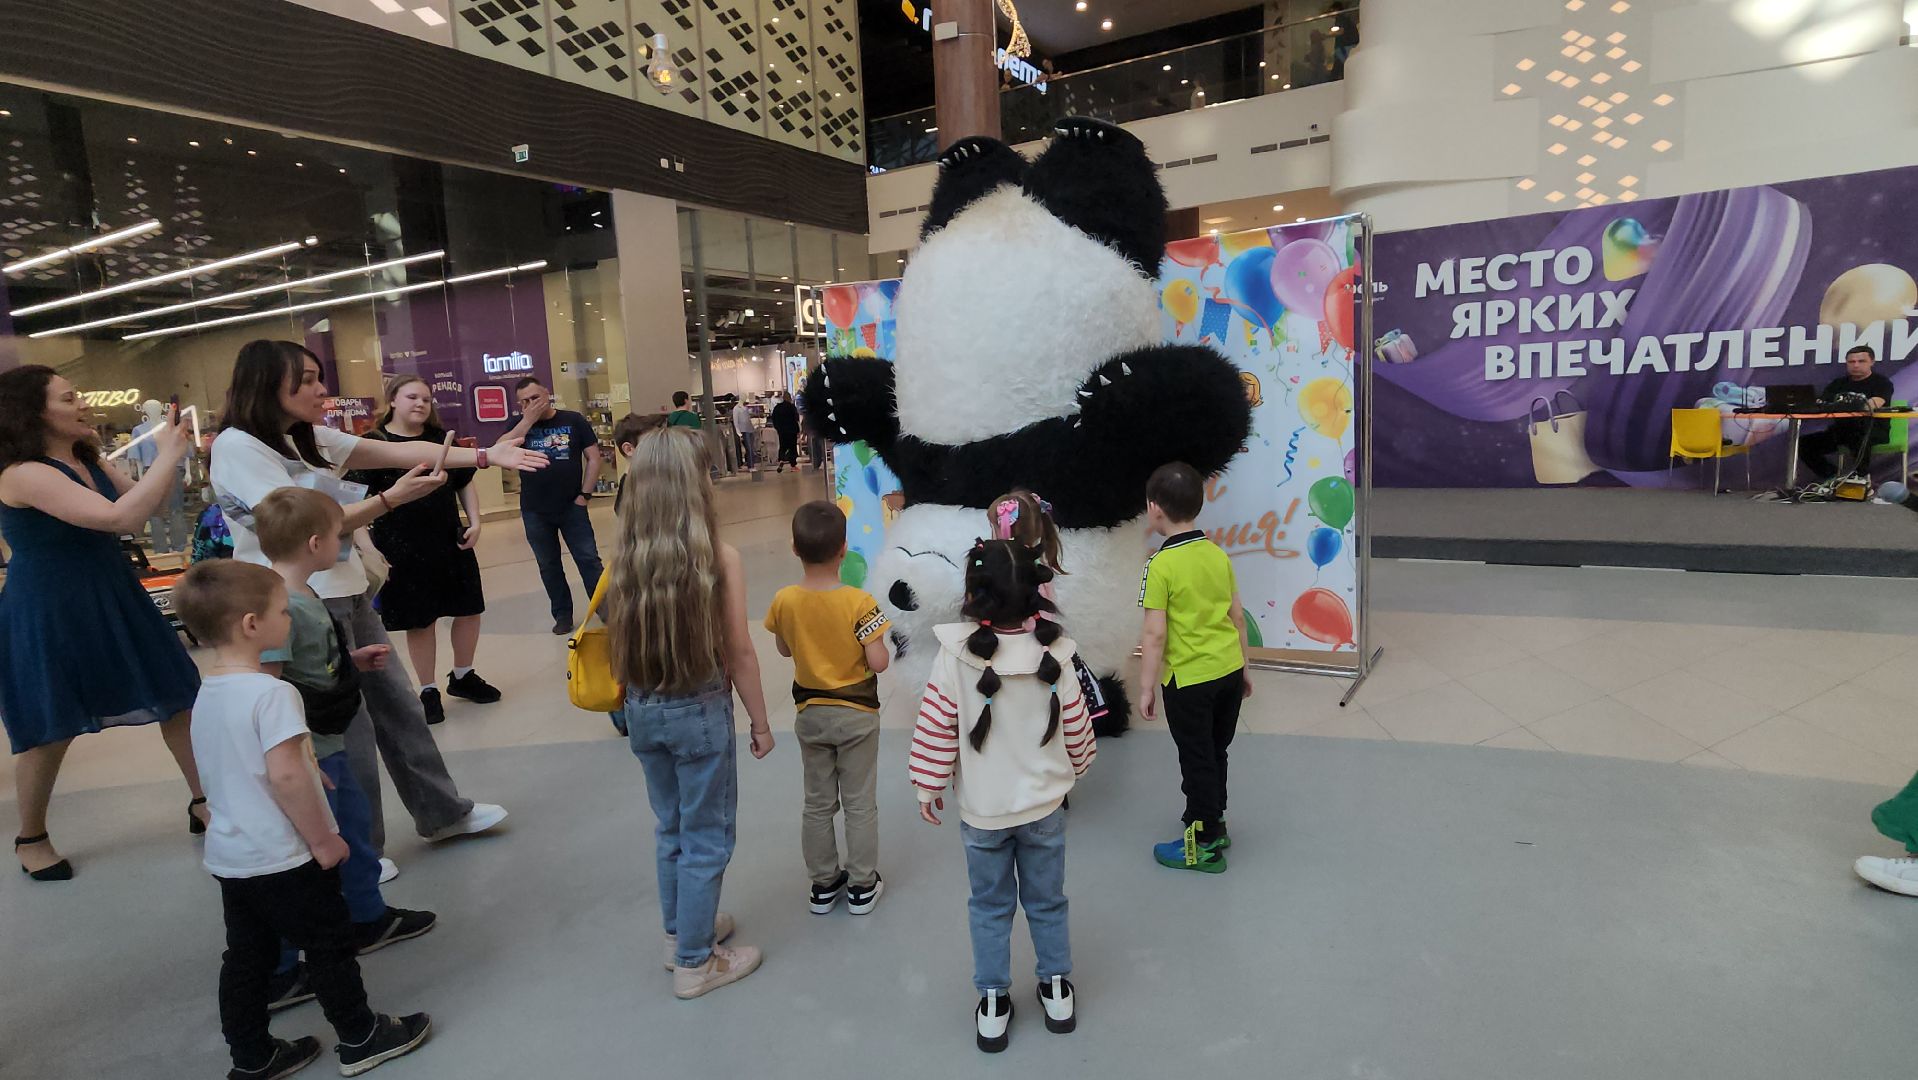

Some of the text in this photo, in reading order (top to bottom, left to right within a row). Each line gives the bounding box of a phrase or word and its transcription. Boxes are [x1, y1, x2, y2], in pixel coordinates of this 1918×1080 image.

[1415, 246, 1593, 298] МЕСТО
[1450, 289, 1636, 339] ЯРКИХ
[483, 351, 533, 373] familia
[1485, 306, 1918, 381] ВПЕЧАТЛЕНИЙ
[432, 382, 462, 392] РЕНДОВ
